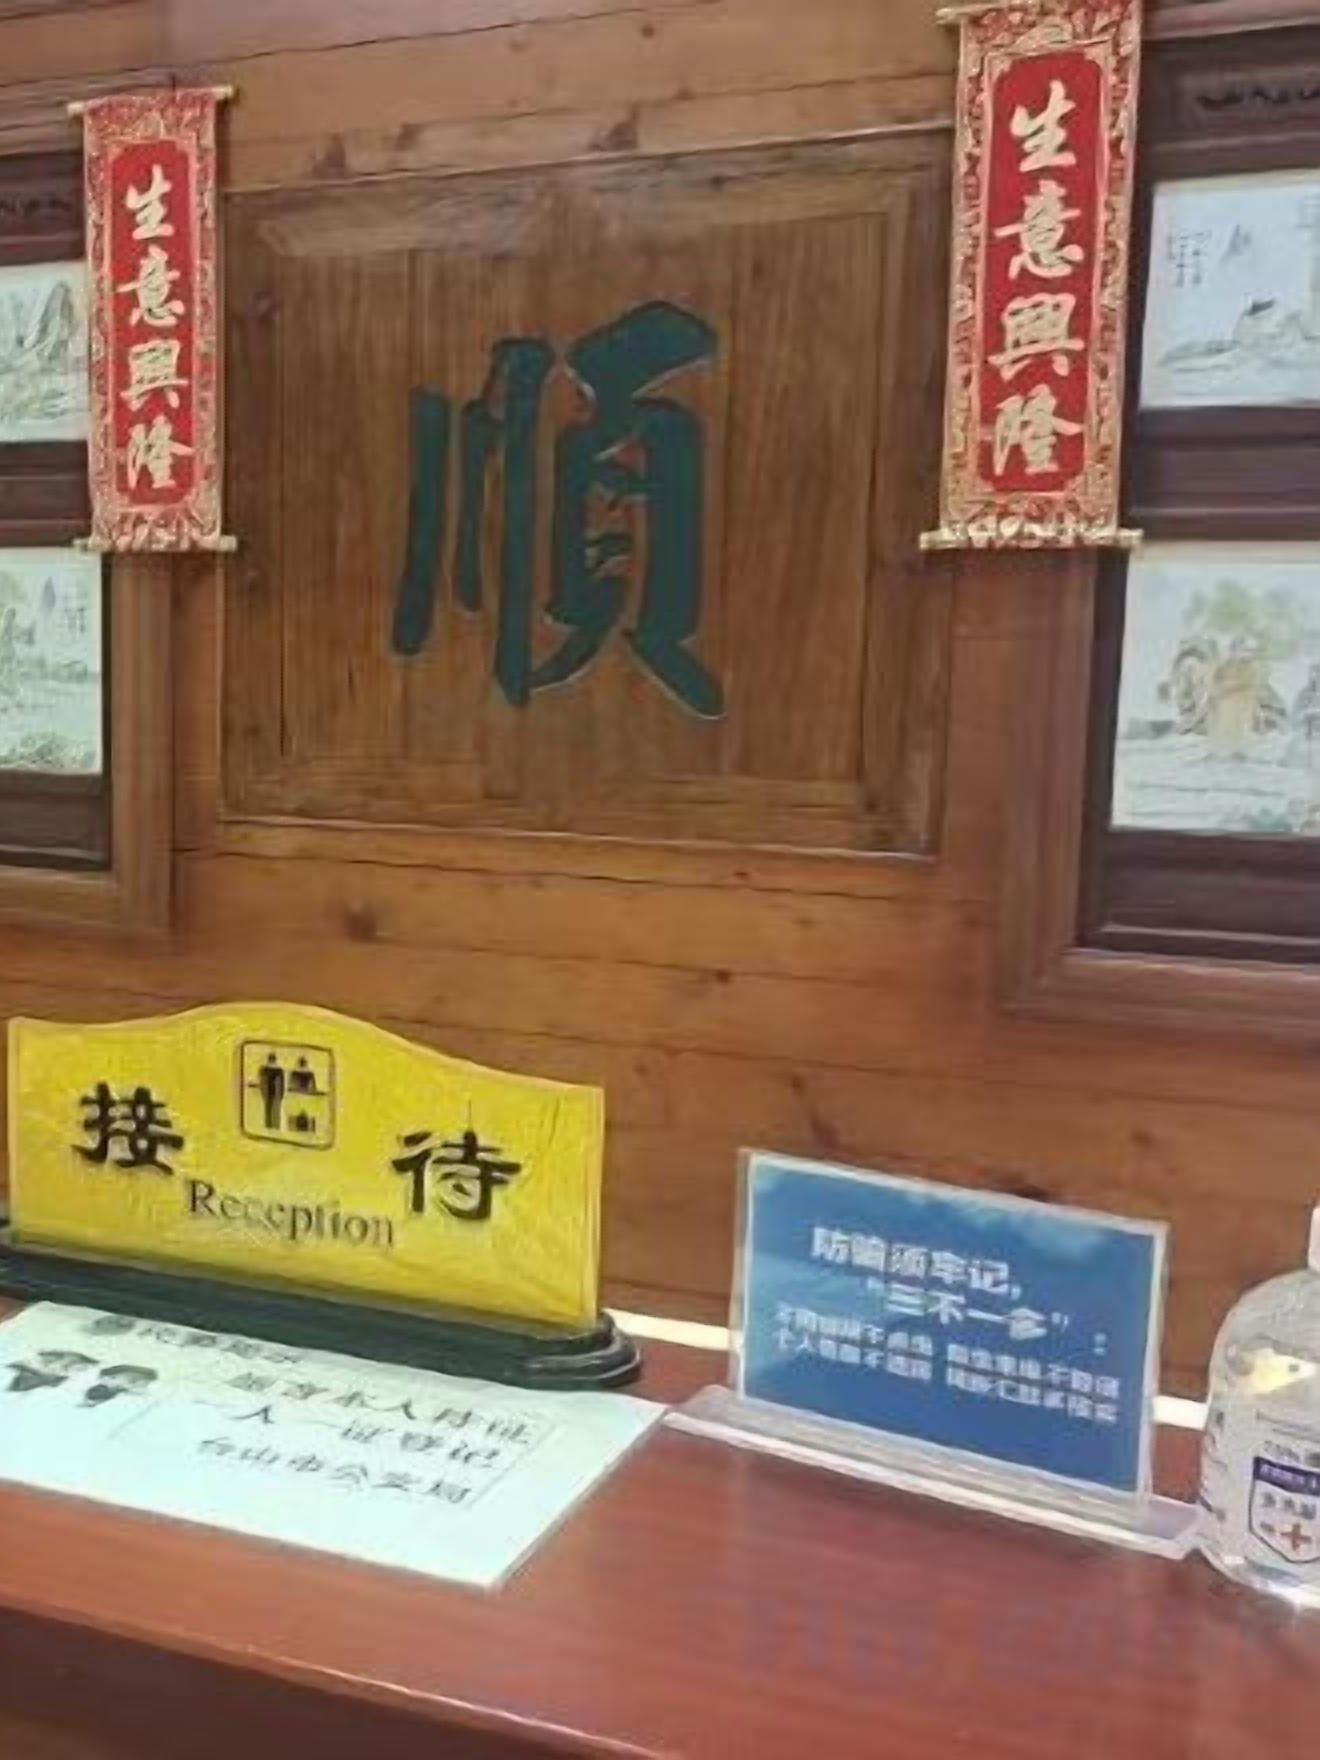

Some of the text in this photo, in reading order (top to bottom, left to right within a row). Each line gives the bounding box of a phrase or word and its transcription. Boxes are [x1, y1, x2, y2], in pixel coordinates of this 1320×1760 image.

[114, 163, 195, 490] 生意興隆
[988, 80, 1085, 475] 生意興隆
[391, 300, 729, 719] 順
[188, 1180, 394, 1249] Reception
